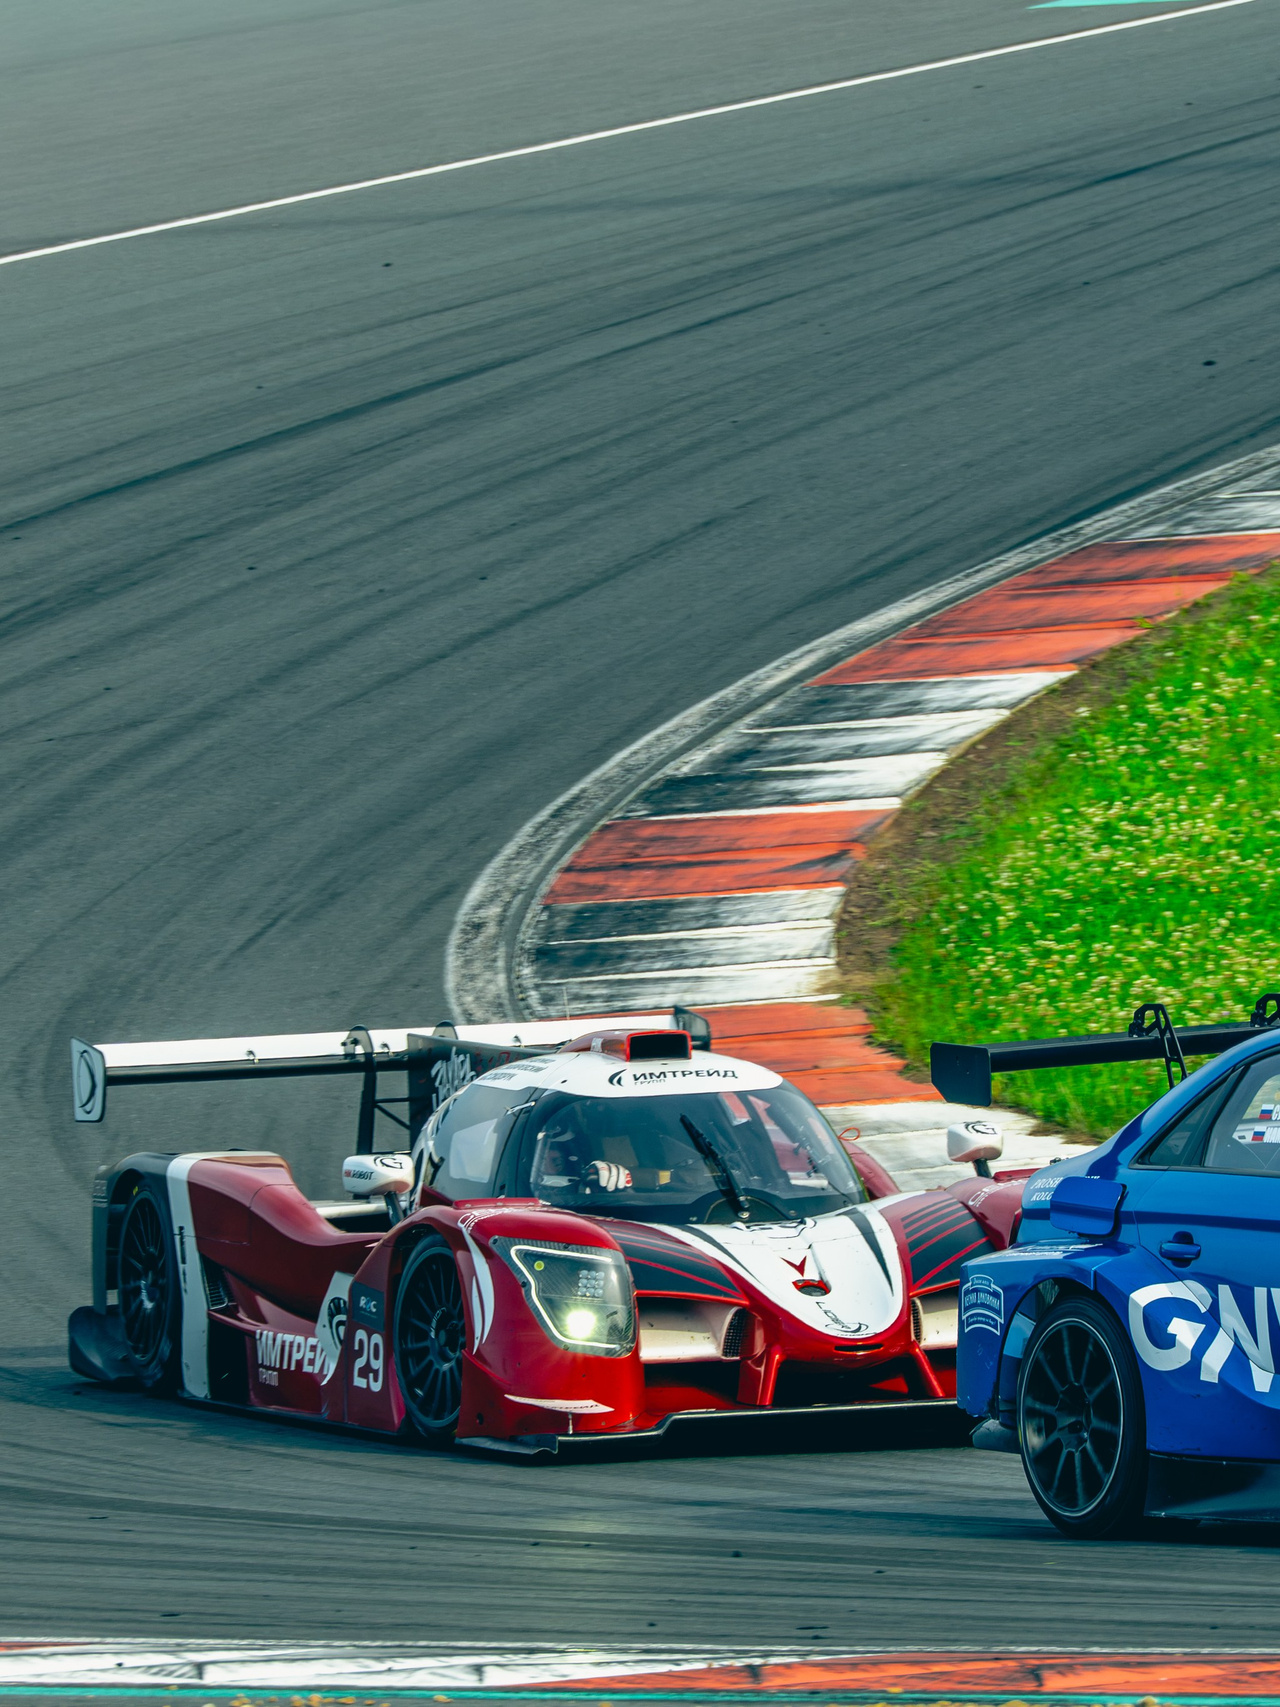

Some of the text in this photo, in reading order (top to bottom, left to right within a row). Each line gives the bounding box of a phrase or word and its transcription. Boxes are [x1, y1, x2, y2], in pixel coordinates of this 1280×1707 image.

[632, 1068, 738, 1081] ИМТРЕЙД
[256, 1329, 332, 1375] ИМТРЕЙ
[353, 1329, 384, 1392] 29
